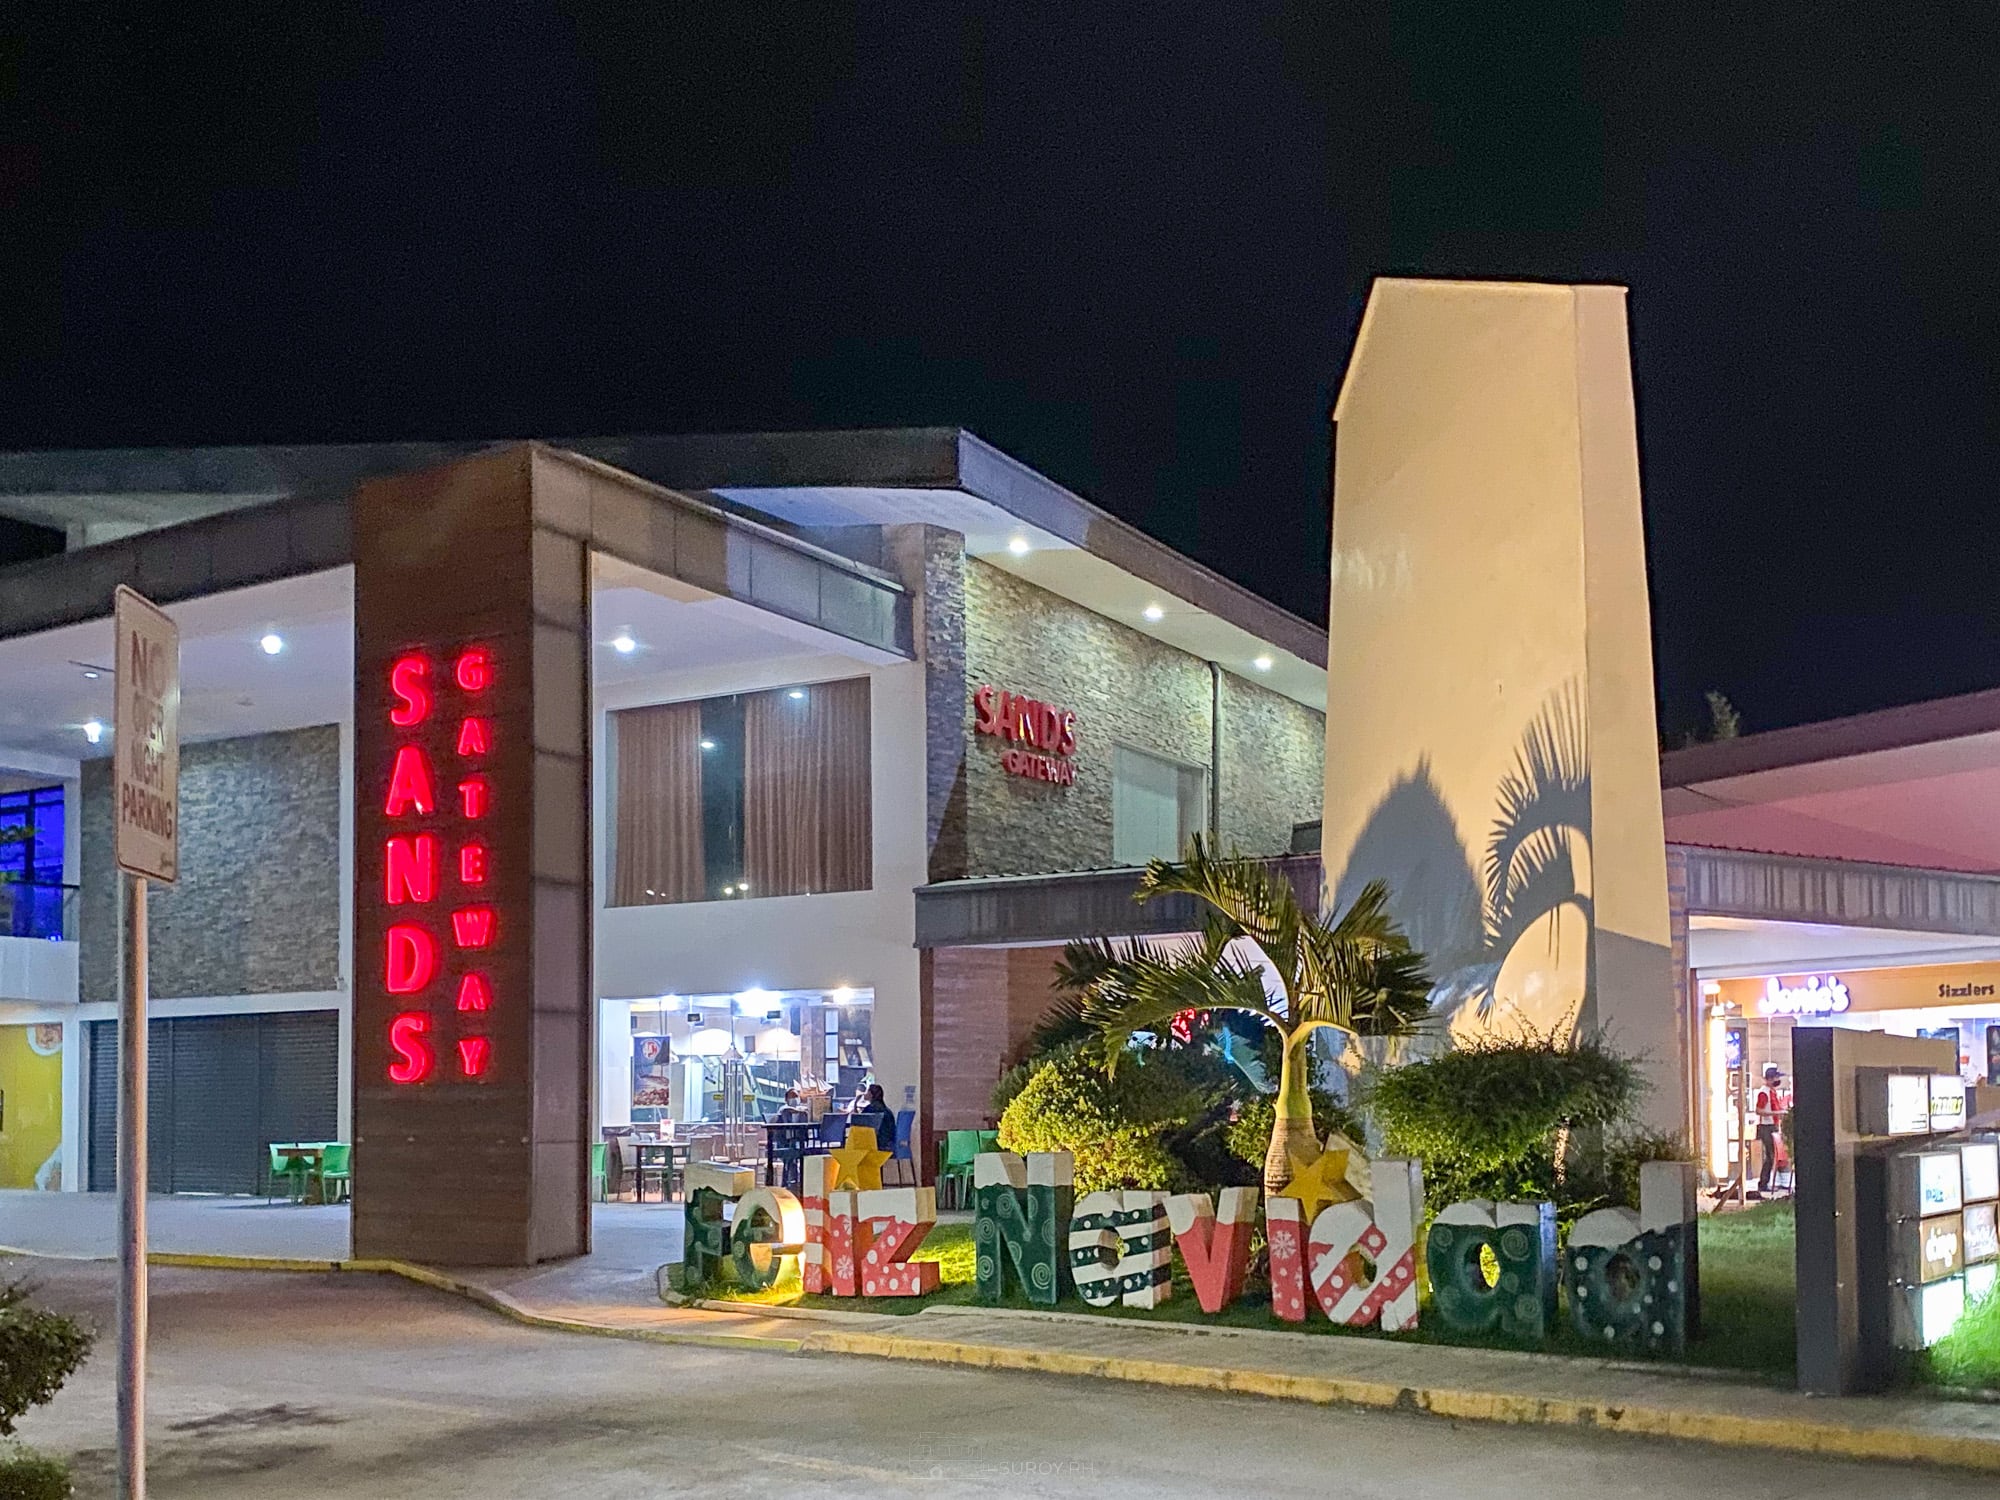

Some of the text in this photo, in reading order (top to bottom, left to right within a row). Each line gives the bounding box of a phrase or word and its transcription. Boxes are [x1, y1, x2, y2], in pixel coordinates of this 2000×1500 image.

[131, 630, 168, 696] NO
[974, 684, 1076, 756] SANDS
[122, 782, 173, 840] PARKING
[386, 656, 434, 1084] SANDS
[453, 652, 493, 1077] GATEWAY
[1938, 983, 1995, 998] Sizzlers
[684, 1126, 1698, 1354] Feliz Navidad
